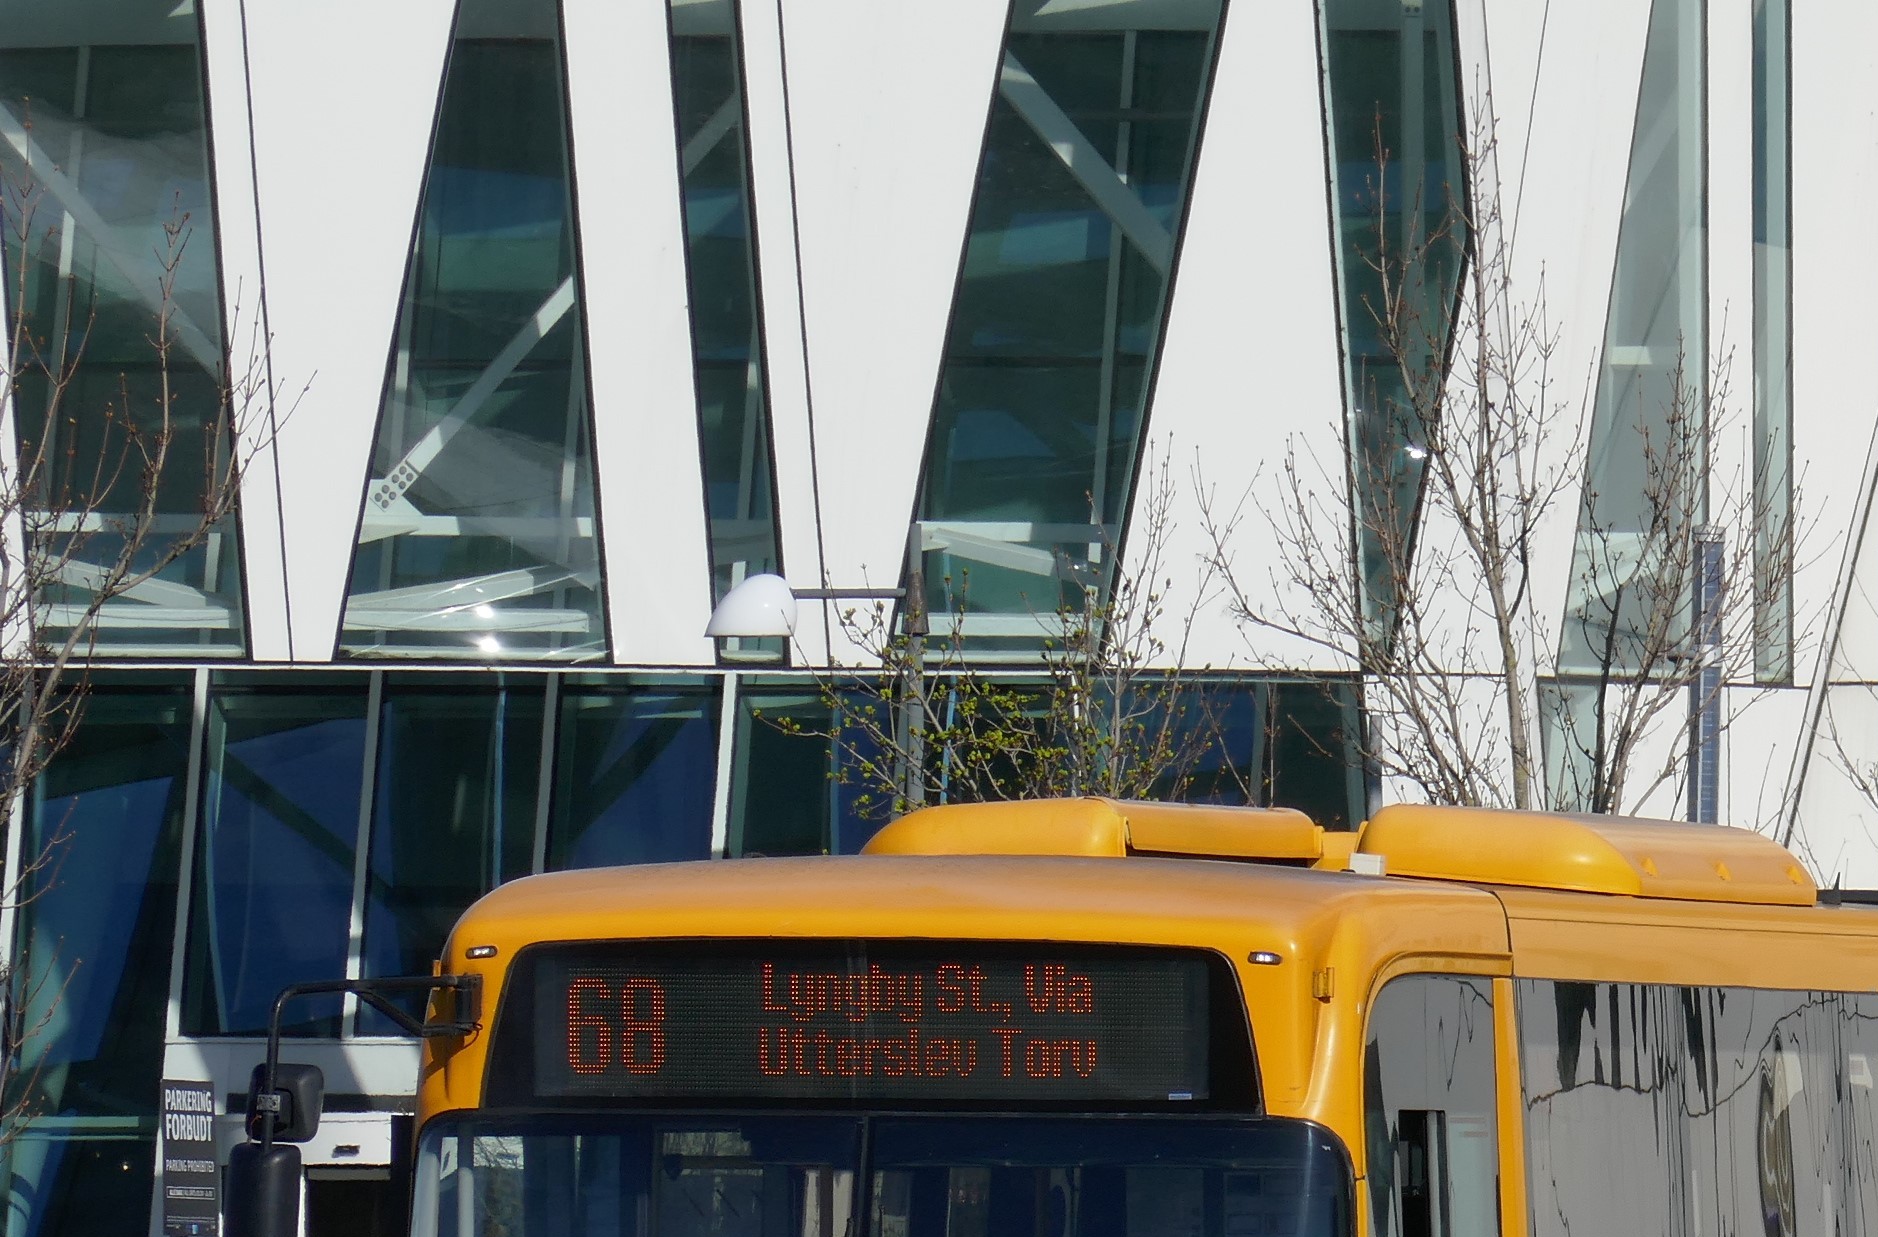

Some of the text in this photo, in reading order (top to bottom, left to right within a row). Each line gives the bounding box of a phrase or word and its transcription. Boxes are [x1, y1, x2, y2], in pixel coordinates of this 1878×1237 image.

[762, 962, 923, 1022] Lyngby
[1025, 964, 1093, 1014] Via
[567, 977, 666, 1075] 68
[759, 1026, 1097, 1078] Utterslev Torv
[165, 1089, 212, 1113] PARKERING
[165, 1113, 213, 1141] FORBUDT
